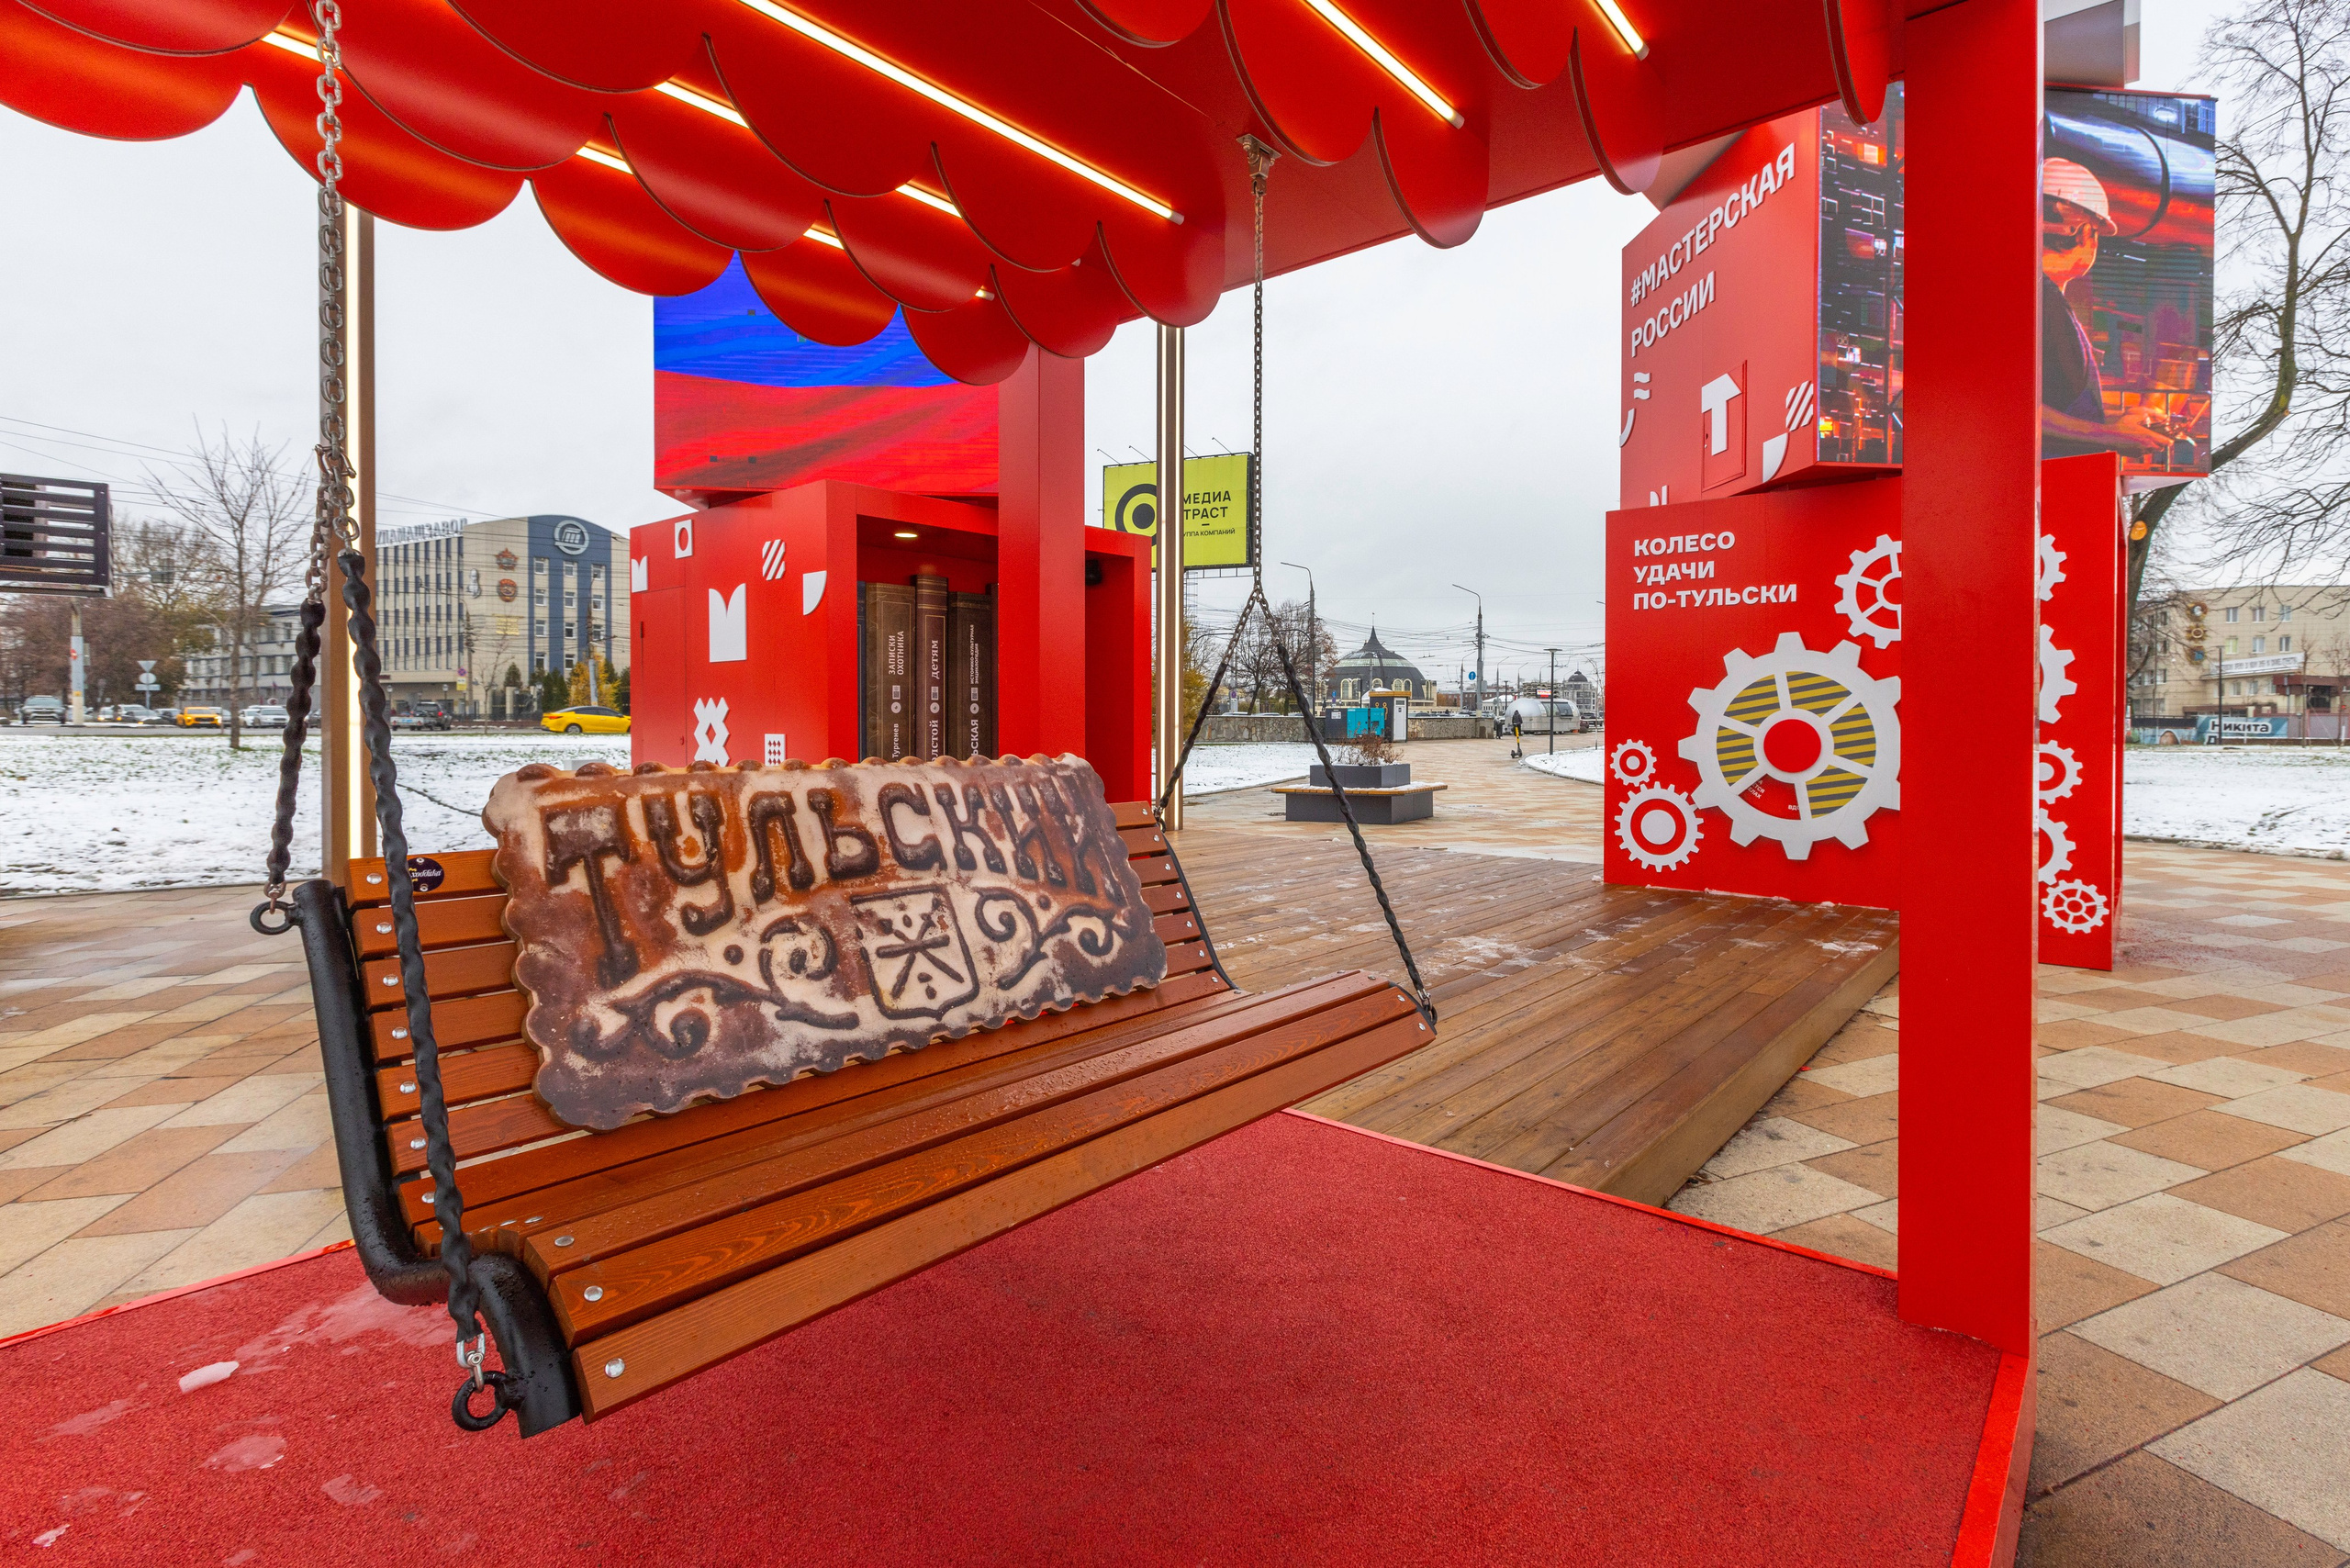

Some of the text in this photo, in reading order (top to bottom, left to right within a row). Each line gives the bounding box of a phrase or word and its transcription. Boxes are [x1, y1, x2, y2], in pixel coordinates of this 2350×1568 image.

[1630, 142, 1795, 307] #МАСТЕРСКАЯ
[1631, 271, 1715, 357] РОССИИ
[1183, 490, 1231, 504] МЕДИА
[1183, 506, 1227, 520] ТРАСТ
[1200, 528, 1236, 537] КОМПАНИЙ
[1634, 531, 1736, 557] КОЛЕСО
[1633, 561, 1715, 587] УДАЧИ
[1633, 584, 1797, 610] ПО-ТУЛЬСКИ
[931, 640, 940, 679] детям
[2210, 720, 2269, 733] Никита
[891, 723, 901, 758] Тургенев
